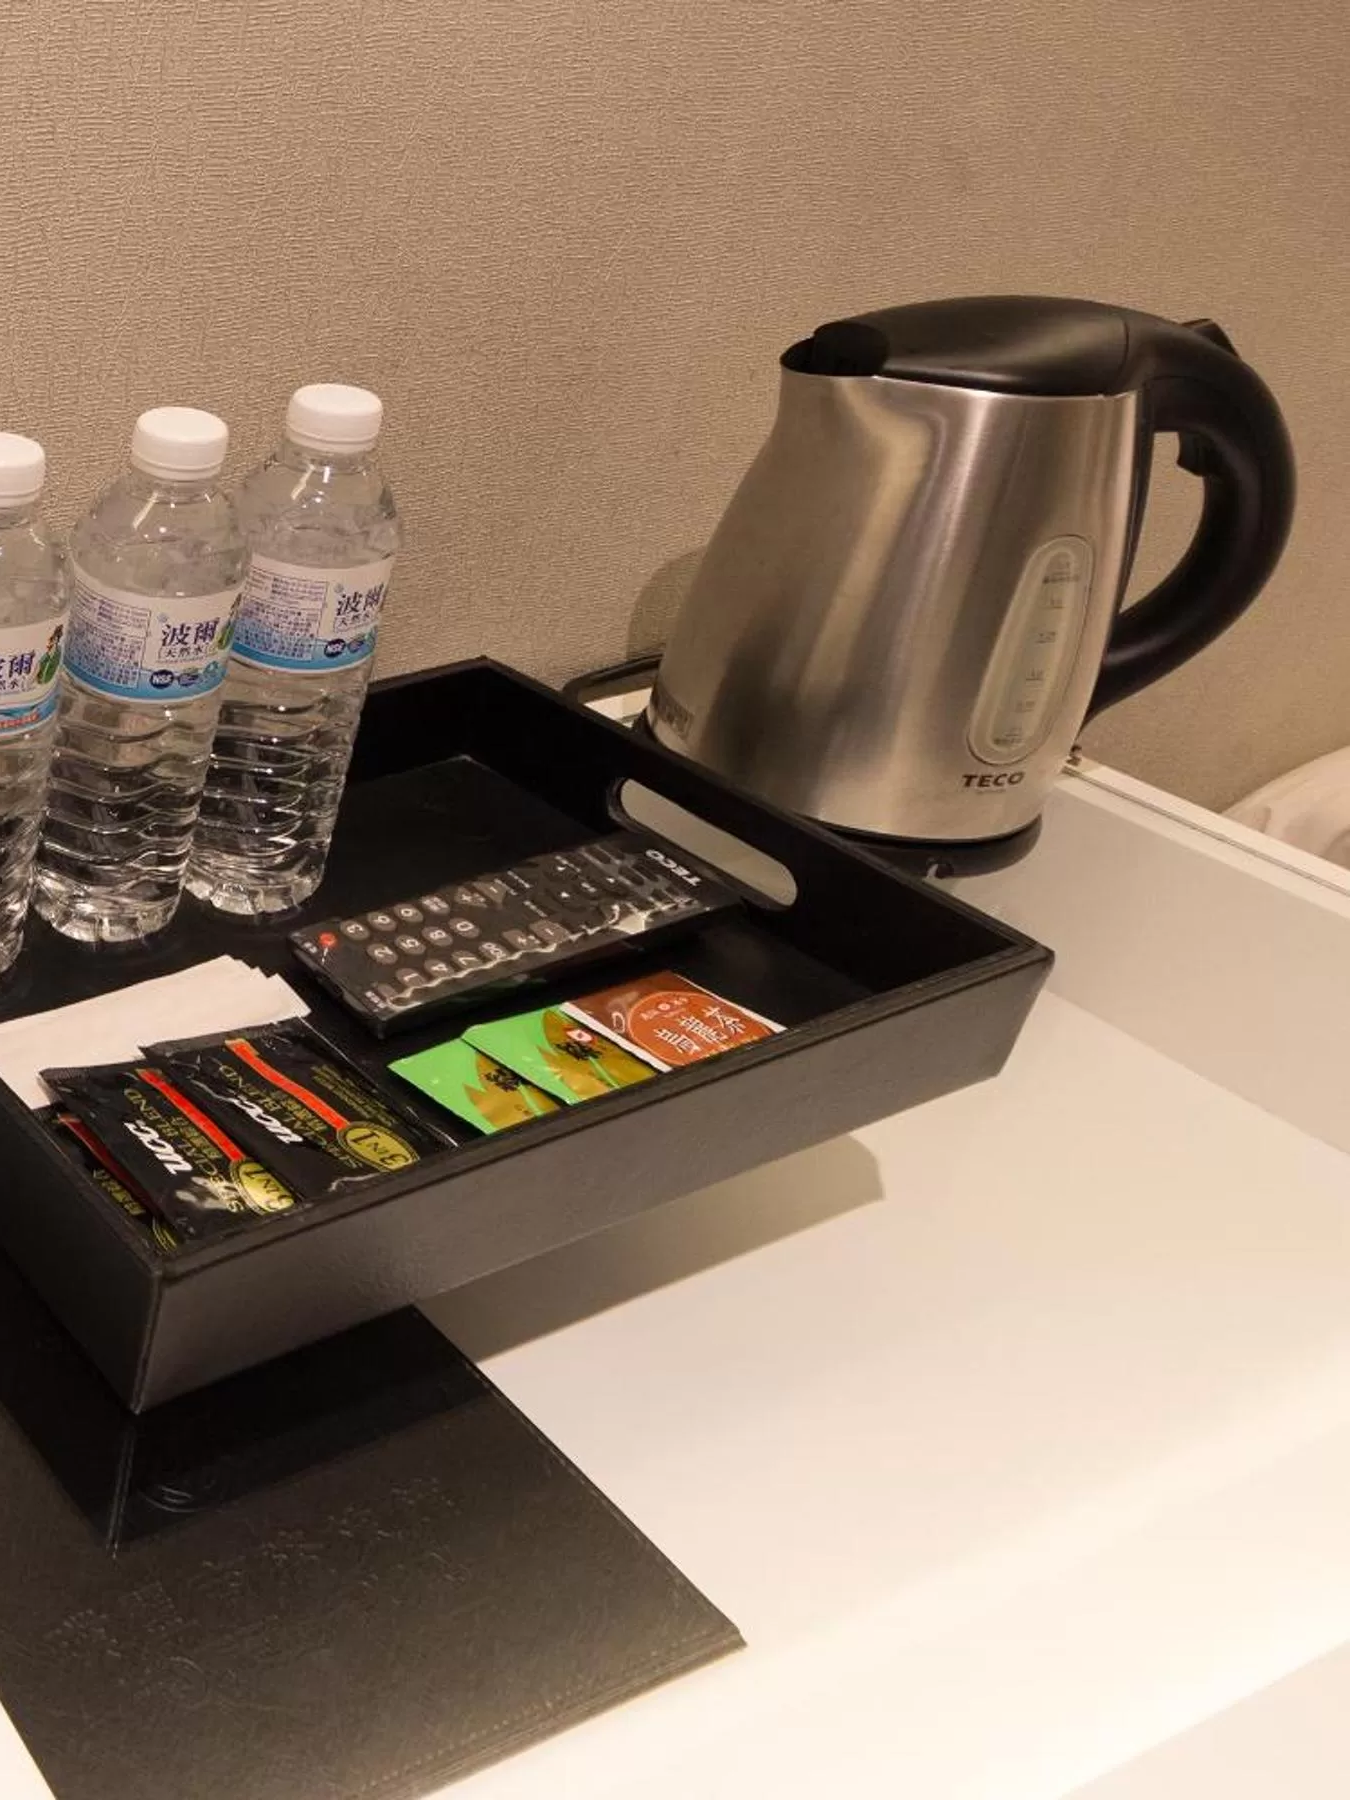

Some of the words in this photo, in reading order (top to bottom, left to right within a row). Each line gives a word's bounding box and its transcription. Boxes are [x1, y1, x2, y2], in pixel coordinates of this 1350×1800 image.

[161, 617, 220, 646] 波爾
[961, 771, 1026, 788] TECO
[644, 848, 702, 885] TECO
[374, 914, 390, 925] 6
[399, 908, 413, 918] 9
[345, 923, 365, 935] 3
[429, 927, 446, 941] 8
[455, 920, 474, 934] 0
[399, 936, 420, 949] 5
[372, 944, 393, 958] 2
[457, 955, 476, 965] 7
[403, 970, 419, 982] 1
[122, 1086, 179, 1138] BLEND
